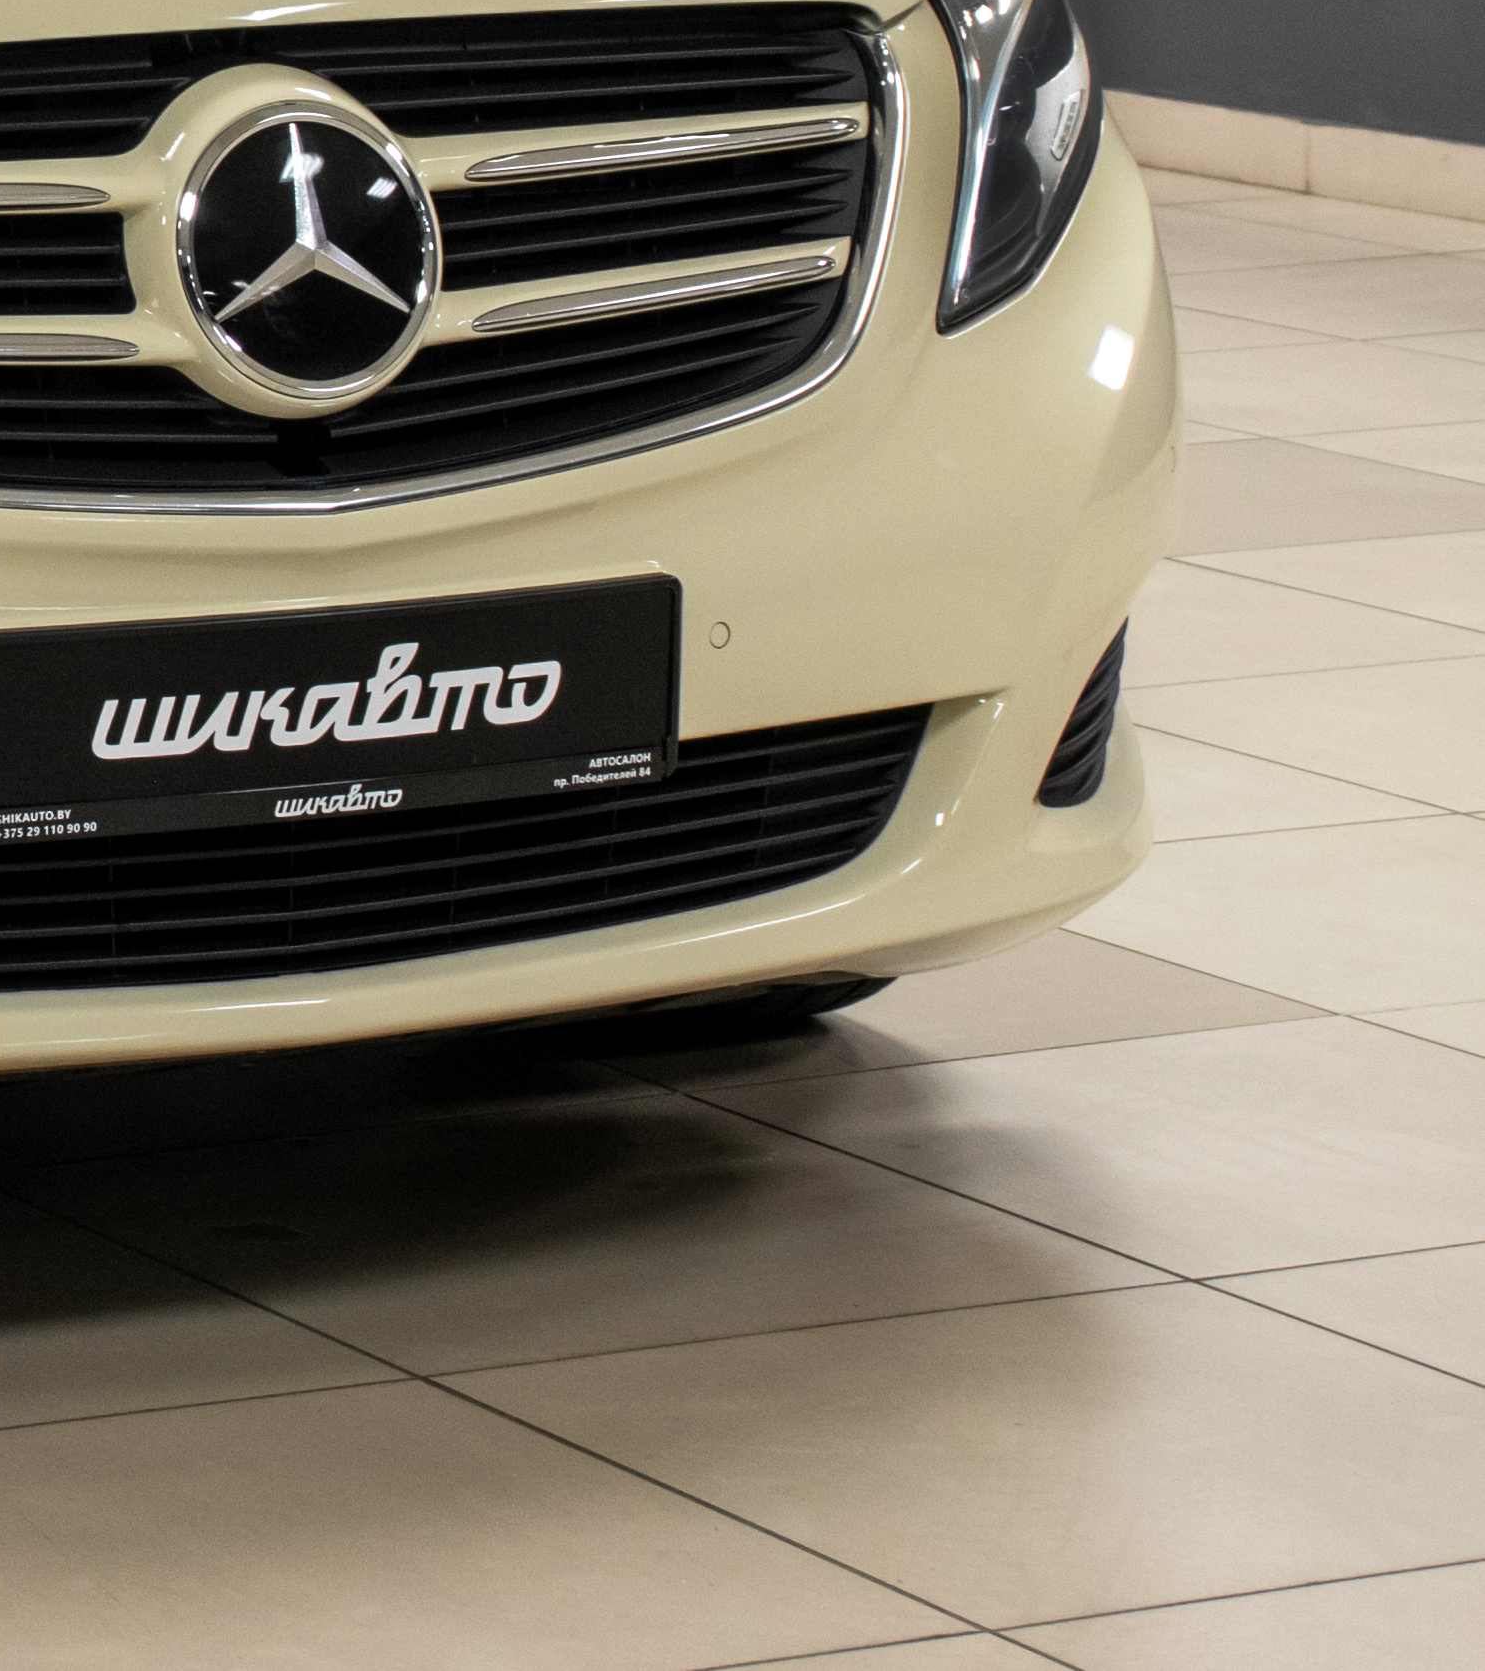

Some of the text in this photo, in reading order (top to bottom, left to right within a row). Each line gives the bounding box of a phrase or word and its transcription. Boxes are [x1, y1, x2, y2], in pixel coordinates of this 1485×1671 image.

[589, 752, 651, 769] АВТОСАЛОН
[553, 766, 651, 789] пр. Победителей 84
[26, 825, 41, 838] 29
[43, 824, 64, 836] 110
[66, 822, 81, 834] 90
[83, 821, 98, 832] 90
